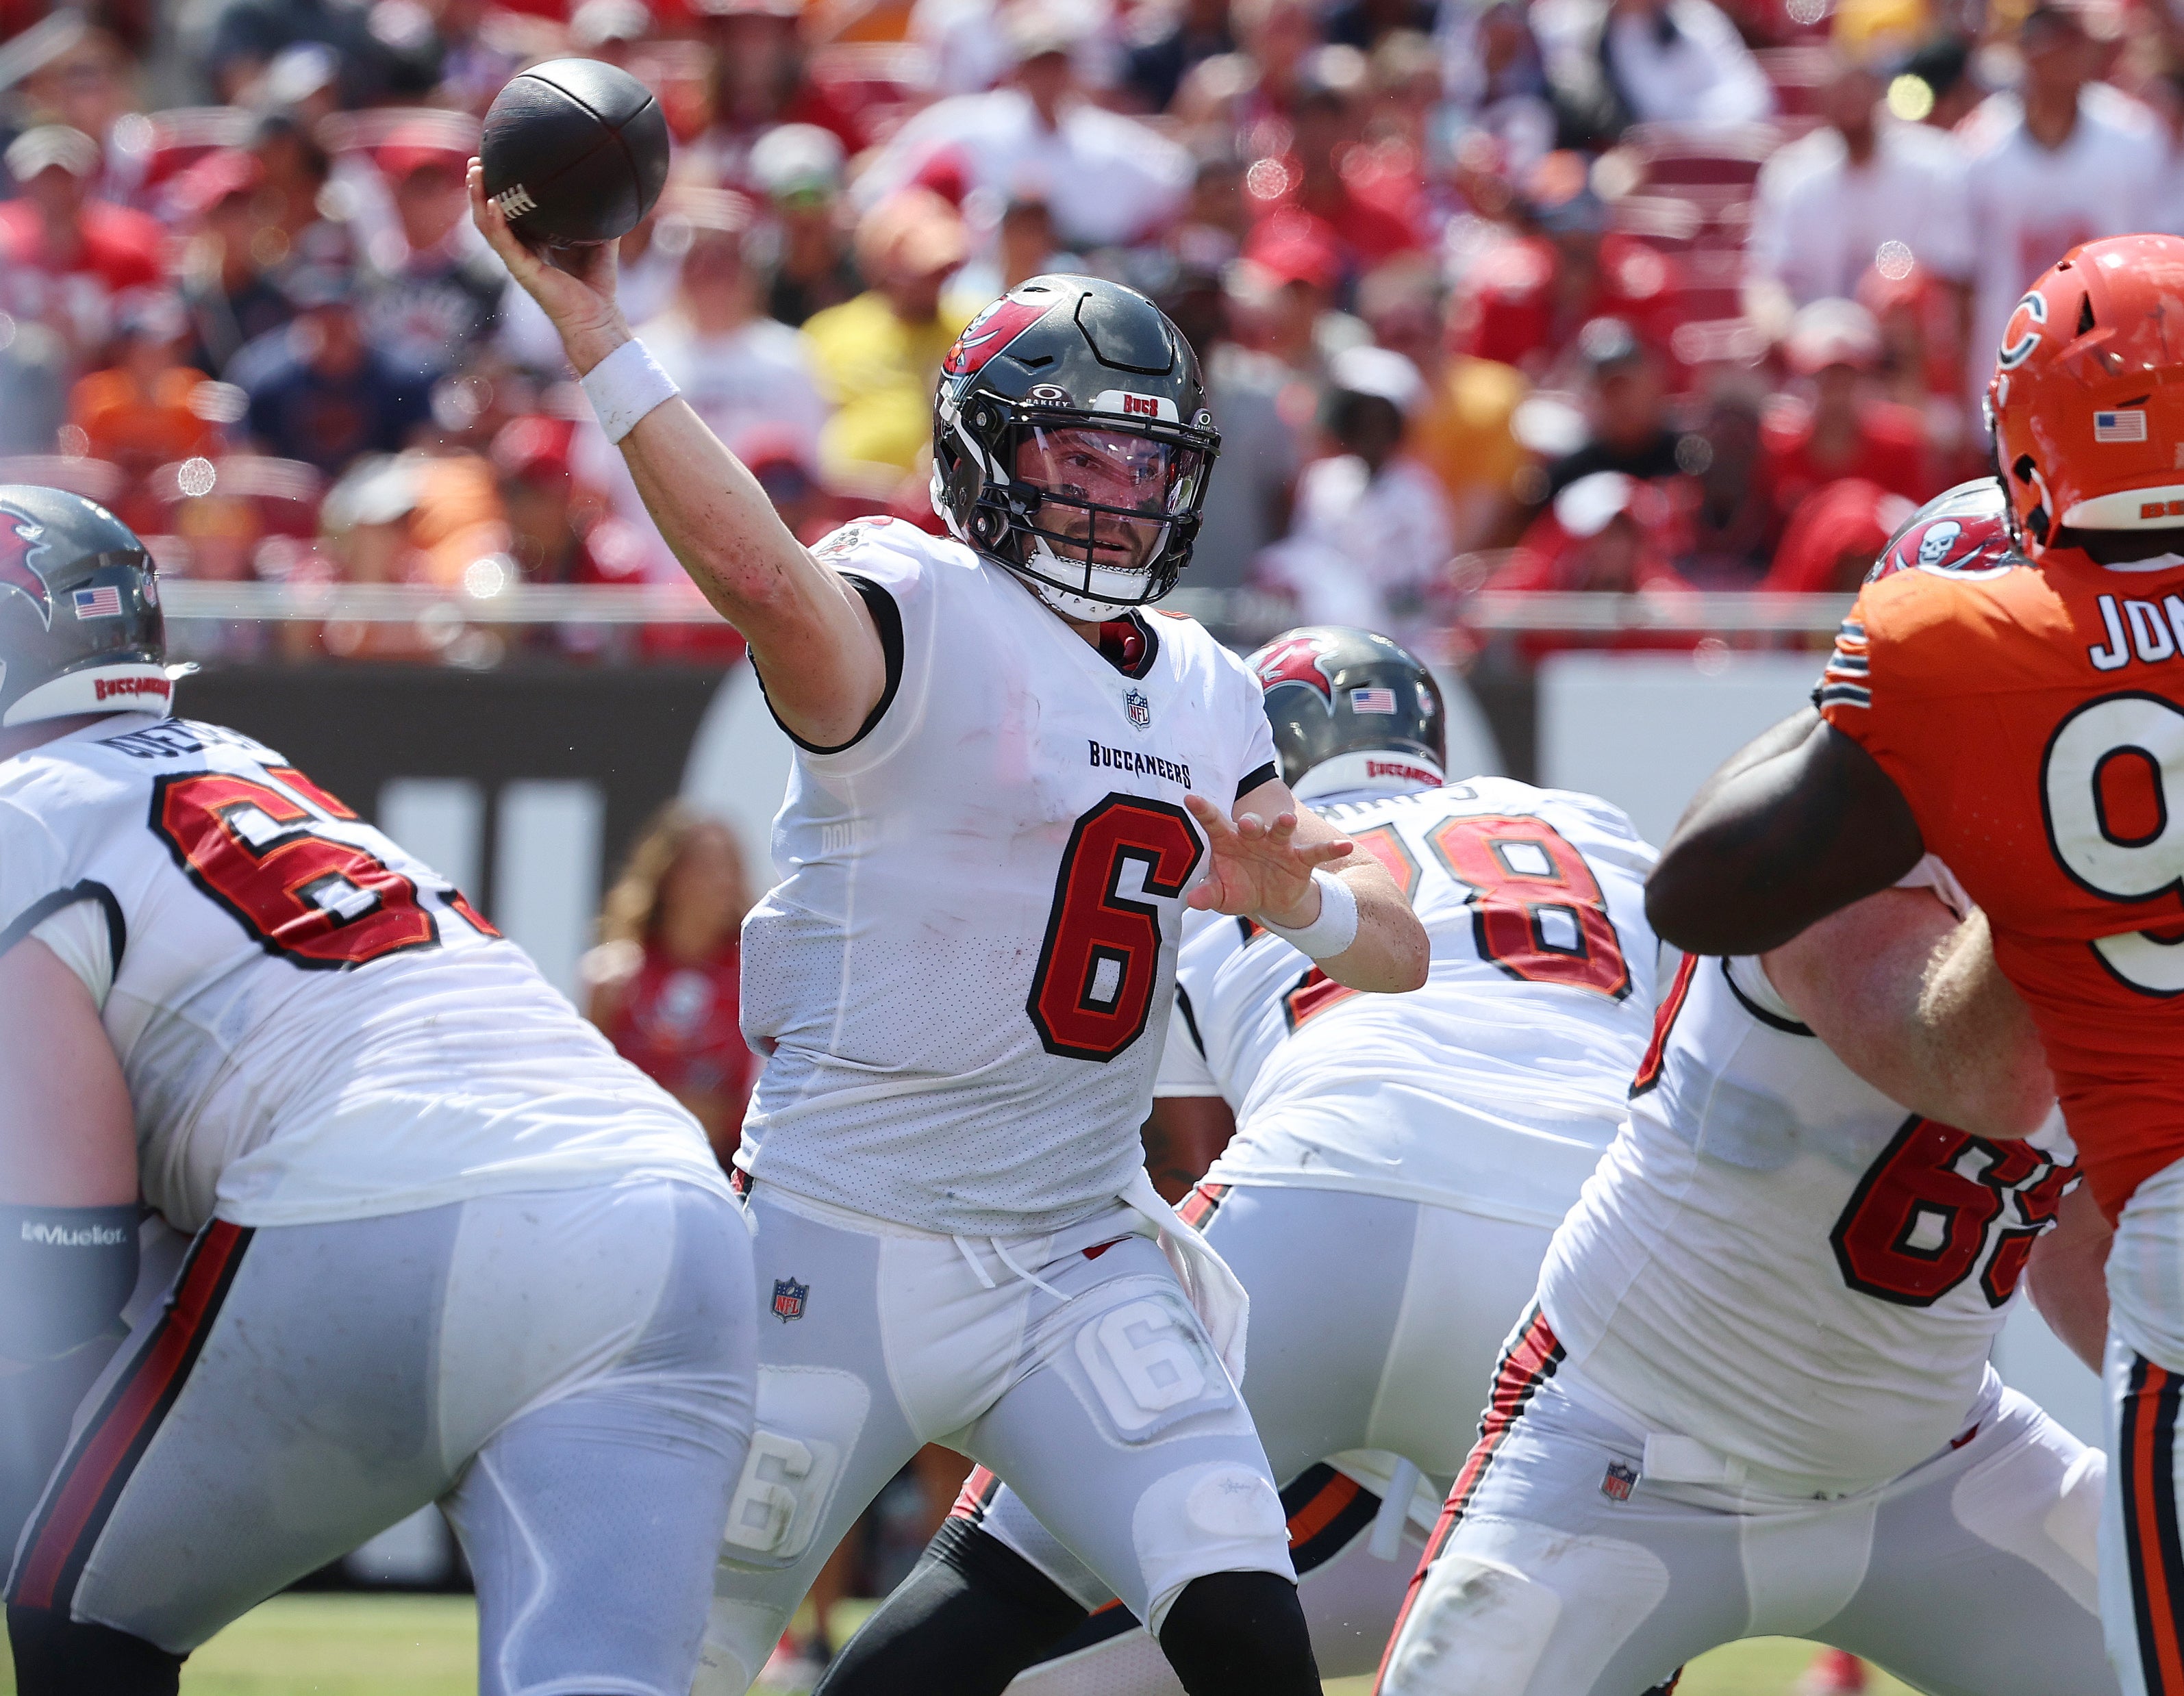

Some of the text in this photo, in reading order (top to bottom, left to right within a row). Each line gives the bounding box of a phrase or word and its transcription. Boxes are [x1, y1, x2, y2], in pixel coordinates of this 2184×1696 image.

[1026, 398, 1068, 407] OAKLEY
[1129, 705, 1149, 722] NFL
[1088, 739, 1192, 789] BUCCANEERS
[1026, 792, 1204, 1063] 6
[775, 1296, 799, 1315] NFL
[1097, 1300, 1206, 1413] 6
[724, 1430, 812, 1552] 6
[1604, 1476, 1629, 1499] NFL
